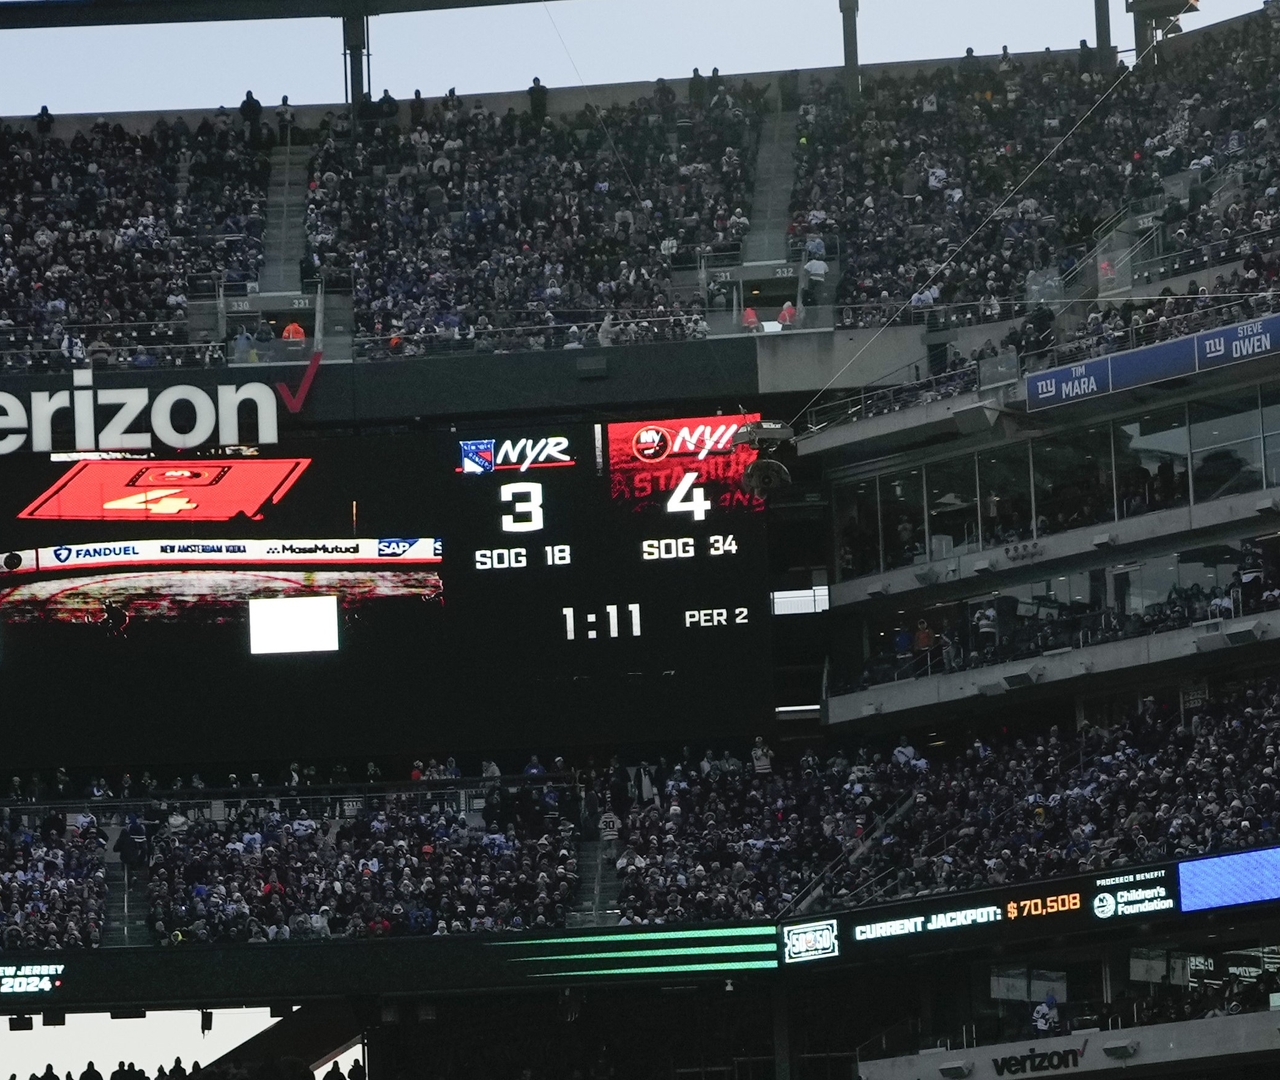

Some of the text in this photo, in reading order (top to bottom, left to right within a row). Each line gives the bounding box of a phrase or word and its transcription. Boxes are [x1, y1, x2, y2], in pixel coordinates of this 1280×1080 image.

[776, 268, 793, 276] 332
[232, 301, 249, 310] 330
[293, 299, 309, 308] 331
[1237, 322, 1263, 338] STEVE
[1232, 333, 1271, 358] OWEN
[1071, 365, 1086, 378] TIM
[1061, 377, 1097, 399] MARA
[495, 436, 571, 472] NYR
[103, 488, 198, 515] 4
[666, 472, 711, 521] 4
[500, 482, 544, 533] 3
[75, 545, 139, 559] FANDUEL
[282, 543, 360, 555] MassMutual
[378, 541, 411, 555] SAP
[642, 534, 738, 560] SOG 34
[475, 545, 571, 570] SOG 18
[562, 603, 641, 640] 1:11
[685, 607, 749, 628] PER 2
[1096, 870, 1166, 887] PROCEEDS BENEFIT
[1116, 886, 1166, 903] Children's
[1117, 899, 1173, 916] Foundation
[854, 916, 925, 941] CURRENT
[927, 907, 1003, 931] JACKPOT:
[1019, 893, 1081, 917] 70,508
[16, 964, 65, 976] JERSEY
[0, 976, 53, 993] 2024
[992, 1045, 1079, 1077] verizon
